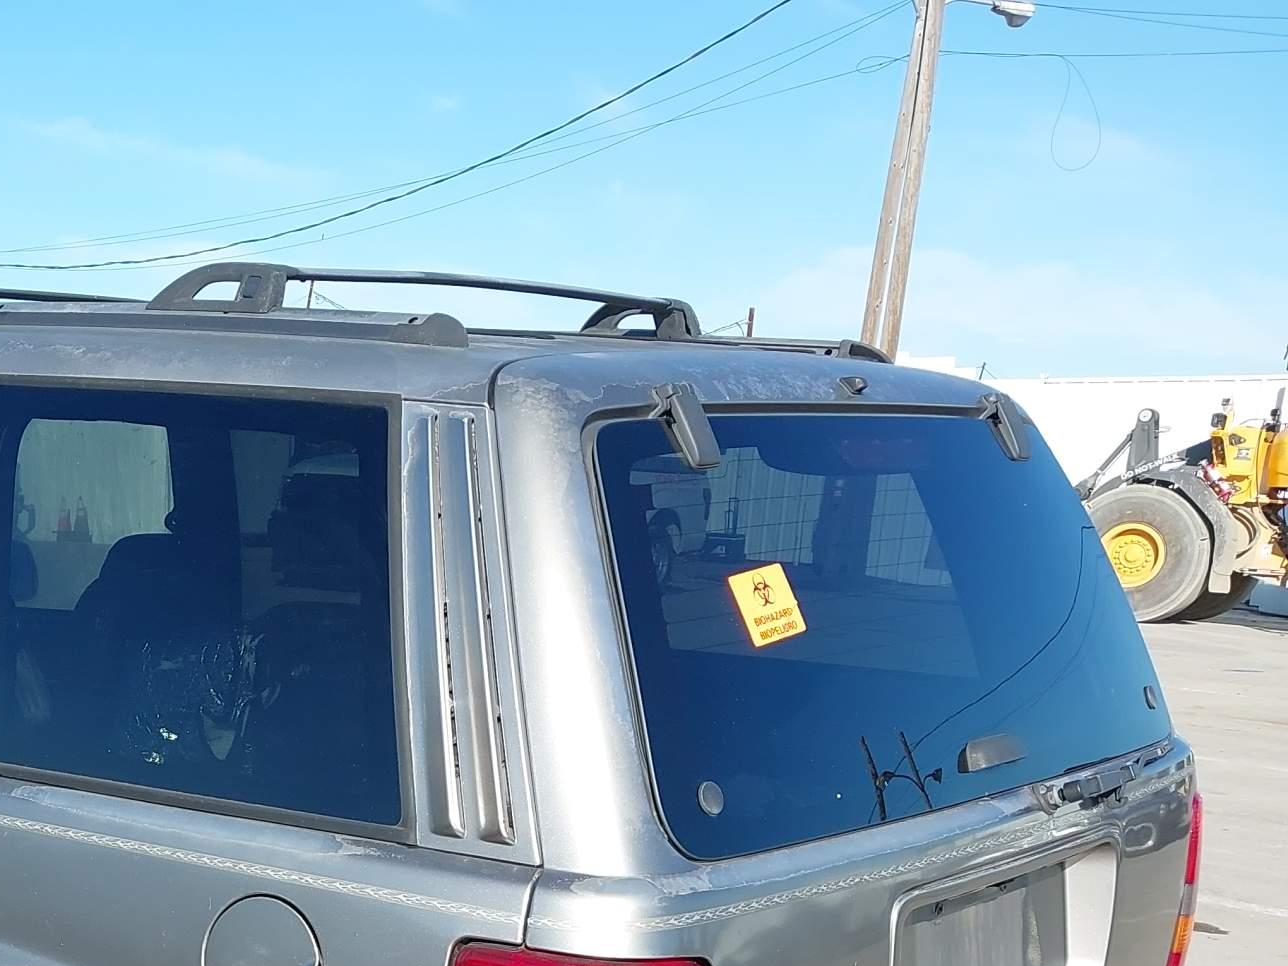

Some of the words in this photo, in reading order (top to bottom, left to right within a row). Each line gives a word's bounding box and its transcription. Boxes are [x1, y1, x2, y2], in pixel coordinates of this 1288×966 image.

[1120, 470, 1134, 480] DO
[754, 607, 793, 627] BIOHAZARD
[759, 620, 798, 640] BIOPELIGRO
